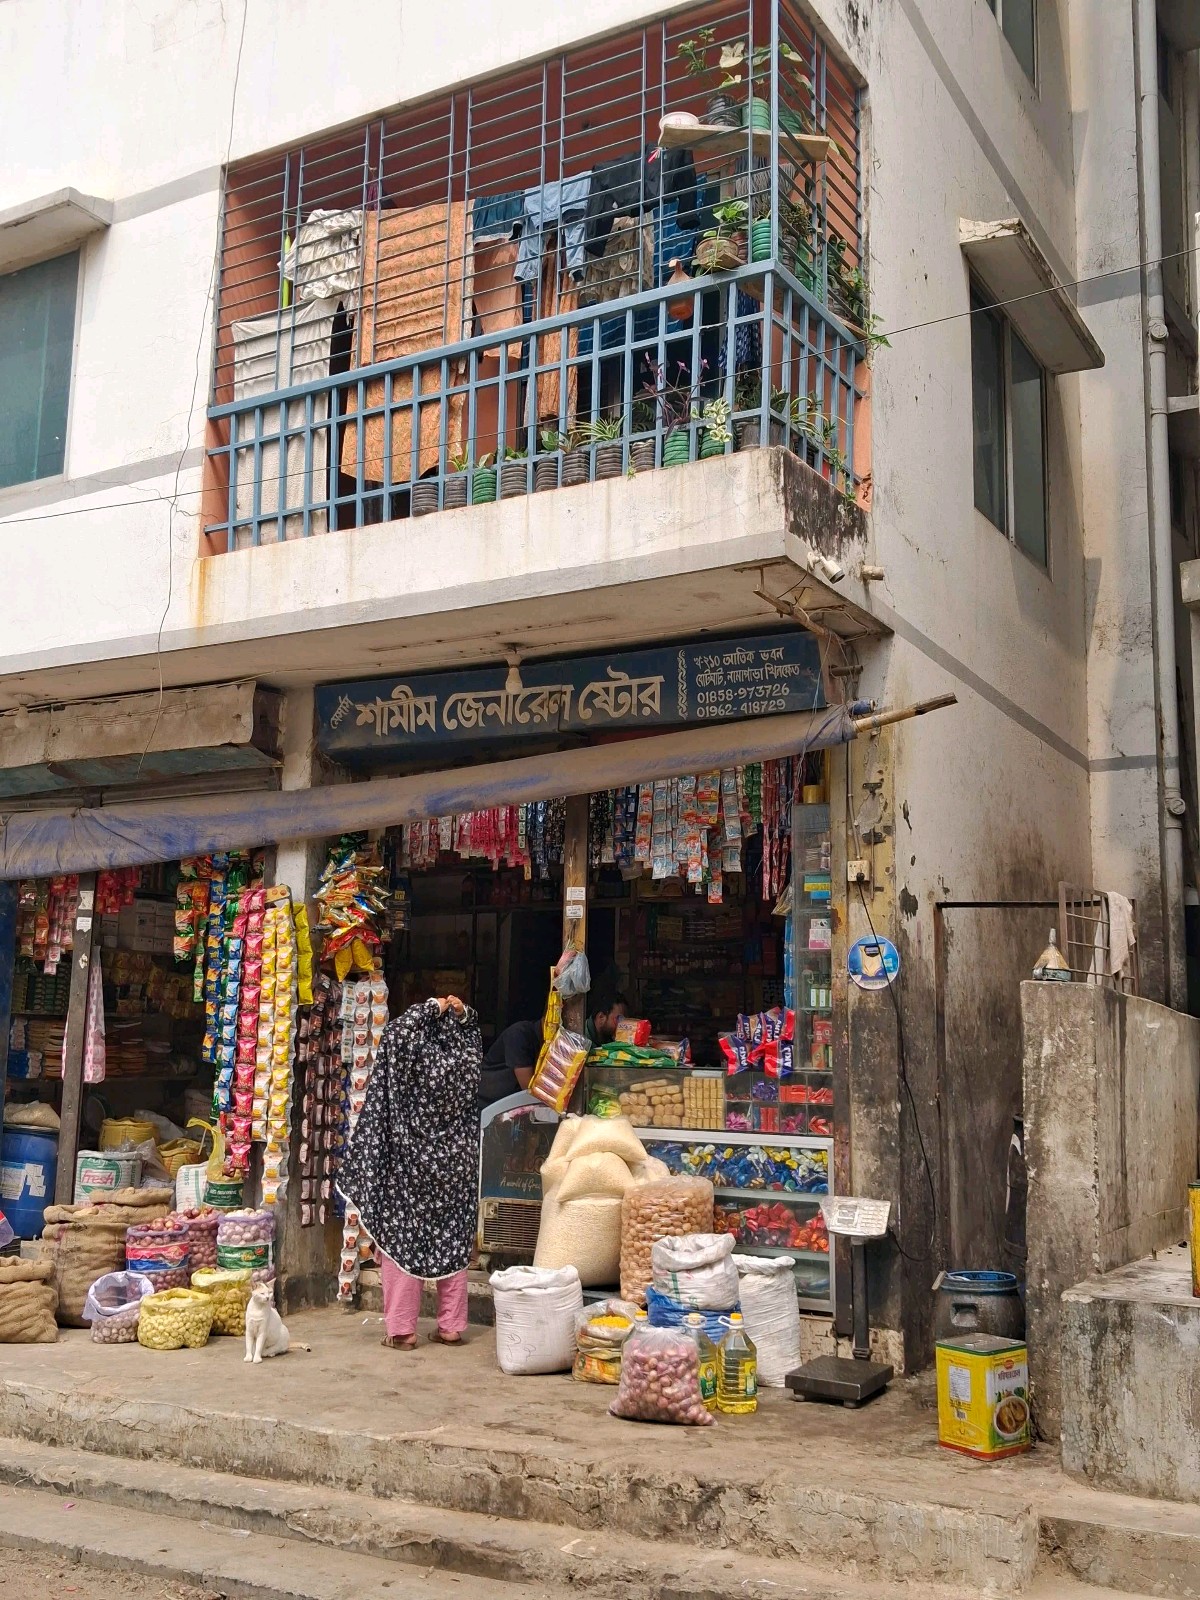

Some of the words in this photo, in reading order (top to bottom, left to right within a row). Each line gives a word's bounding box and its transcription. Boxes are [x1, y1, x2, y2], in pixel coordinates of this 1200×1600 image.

[722, 646, 756, 666] আতিক
[759, 647, 785, 661] ভবন
[697, 682, 790, 704] 01858-973726
[355, 684, 438, 737] শামীম
[443, 683, 575, 731] জেনারেল
[783, 1047, 792, 1068] AKIJ
